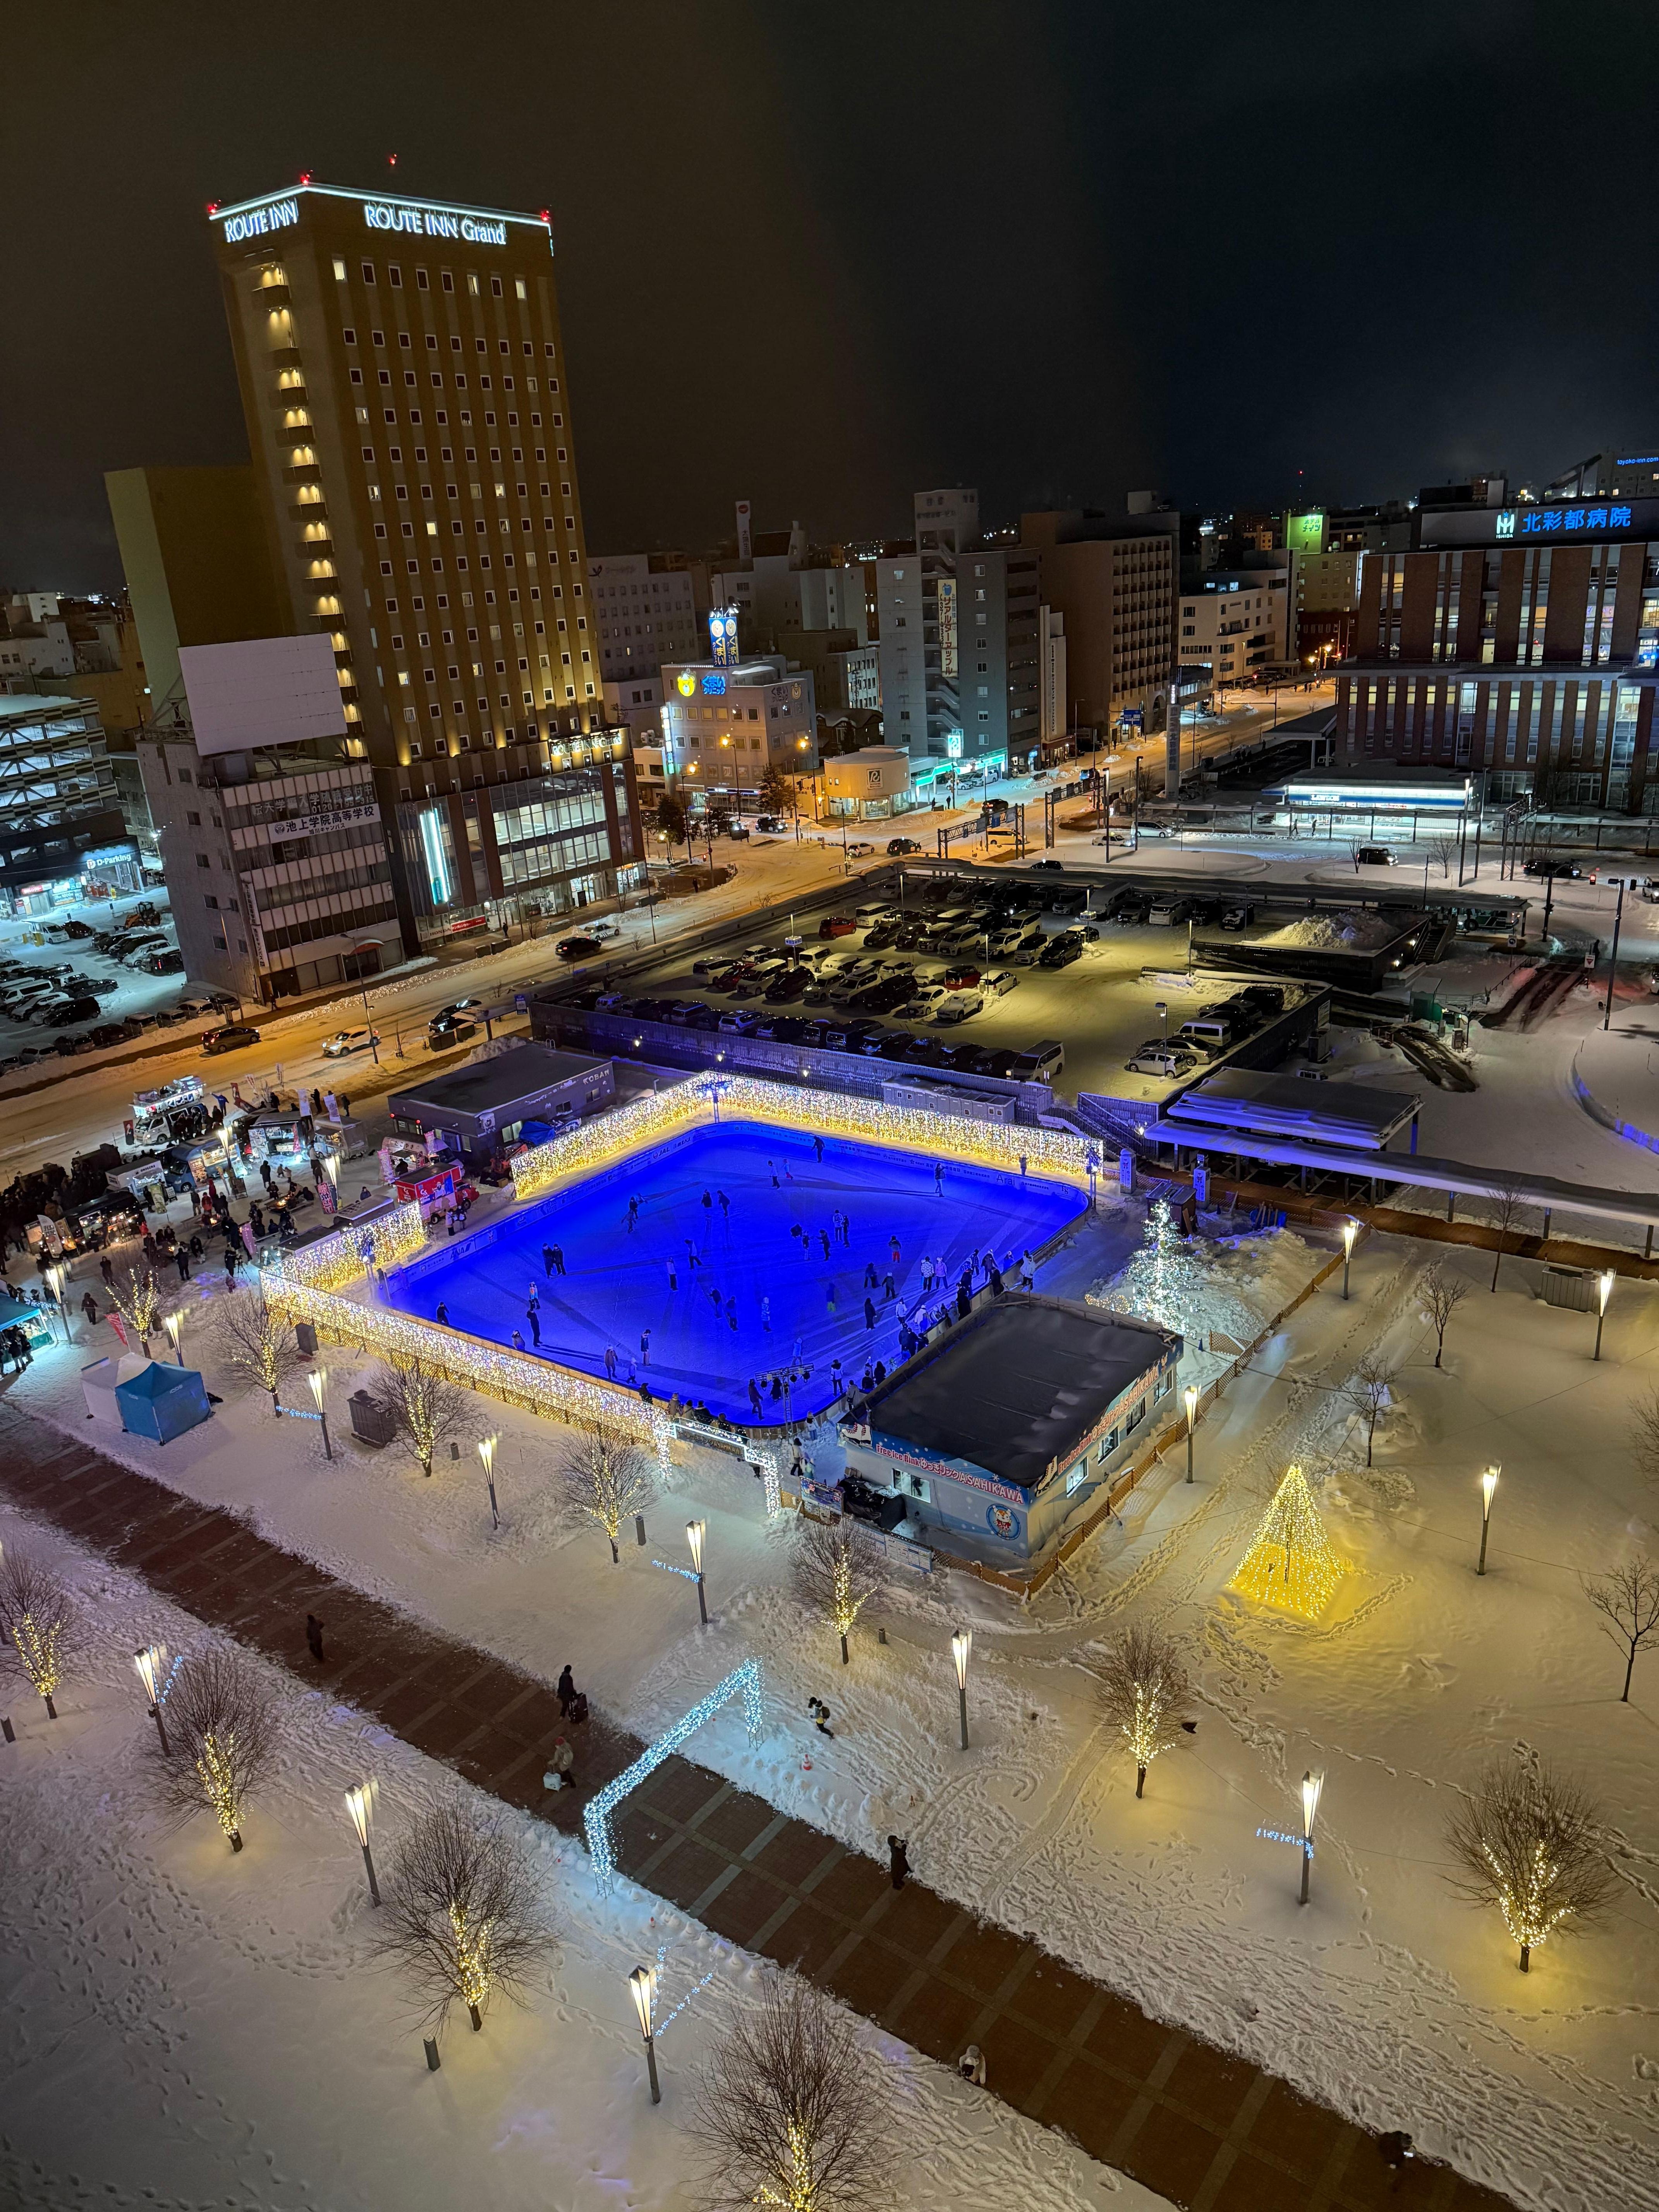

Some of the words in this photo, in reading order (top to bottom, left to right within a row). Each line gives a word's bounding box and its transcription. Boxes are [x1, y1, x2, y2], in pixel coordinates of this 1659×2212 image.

[225, 209, 268, 243] ROUTE
[269, 201, 298, 230] INN
[364, 204, 422, 234] ROUTE
[425, 214, 459, 239] INN
[462, 219, 506, 245] Grand
[1522, 507, 1631, 533] 北彩都病院
[716, 637, 724, 665] くまい
[702, 676, 725, 687] くまい
[771, 686, 788, 696] くまい
[286, 805, 374, 833] 池上学院高等学校
[309, 823, 345, 835] 旭川キャンパス
[97, 854, 132, 866] D-Parking
[430, 928, 451, 936] HONDA
[583, 1069, 610, 1084] KOBAN
[659, 1147, 670, 1156] JAL
[996, 1174, 1015, 1186] Arai
[450, 1246, 465, 1260] ANA
[1058, 1458, 1070, 1475] Free
[1079, 1433, 1092, 1453] Rink
[1120, 1365, 1159, 1415] ASAHIKAWA
[876, 1444, 891, 1456] Free
[892, 1450, 903, 1461] Ice
[903, 1454, 920, 1467] Rink
[919, 1457, 960, 1480] ゆっきリンク
[958, 1472, 1024, 1505] ASAHIKAWA
